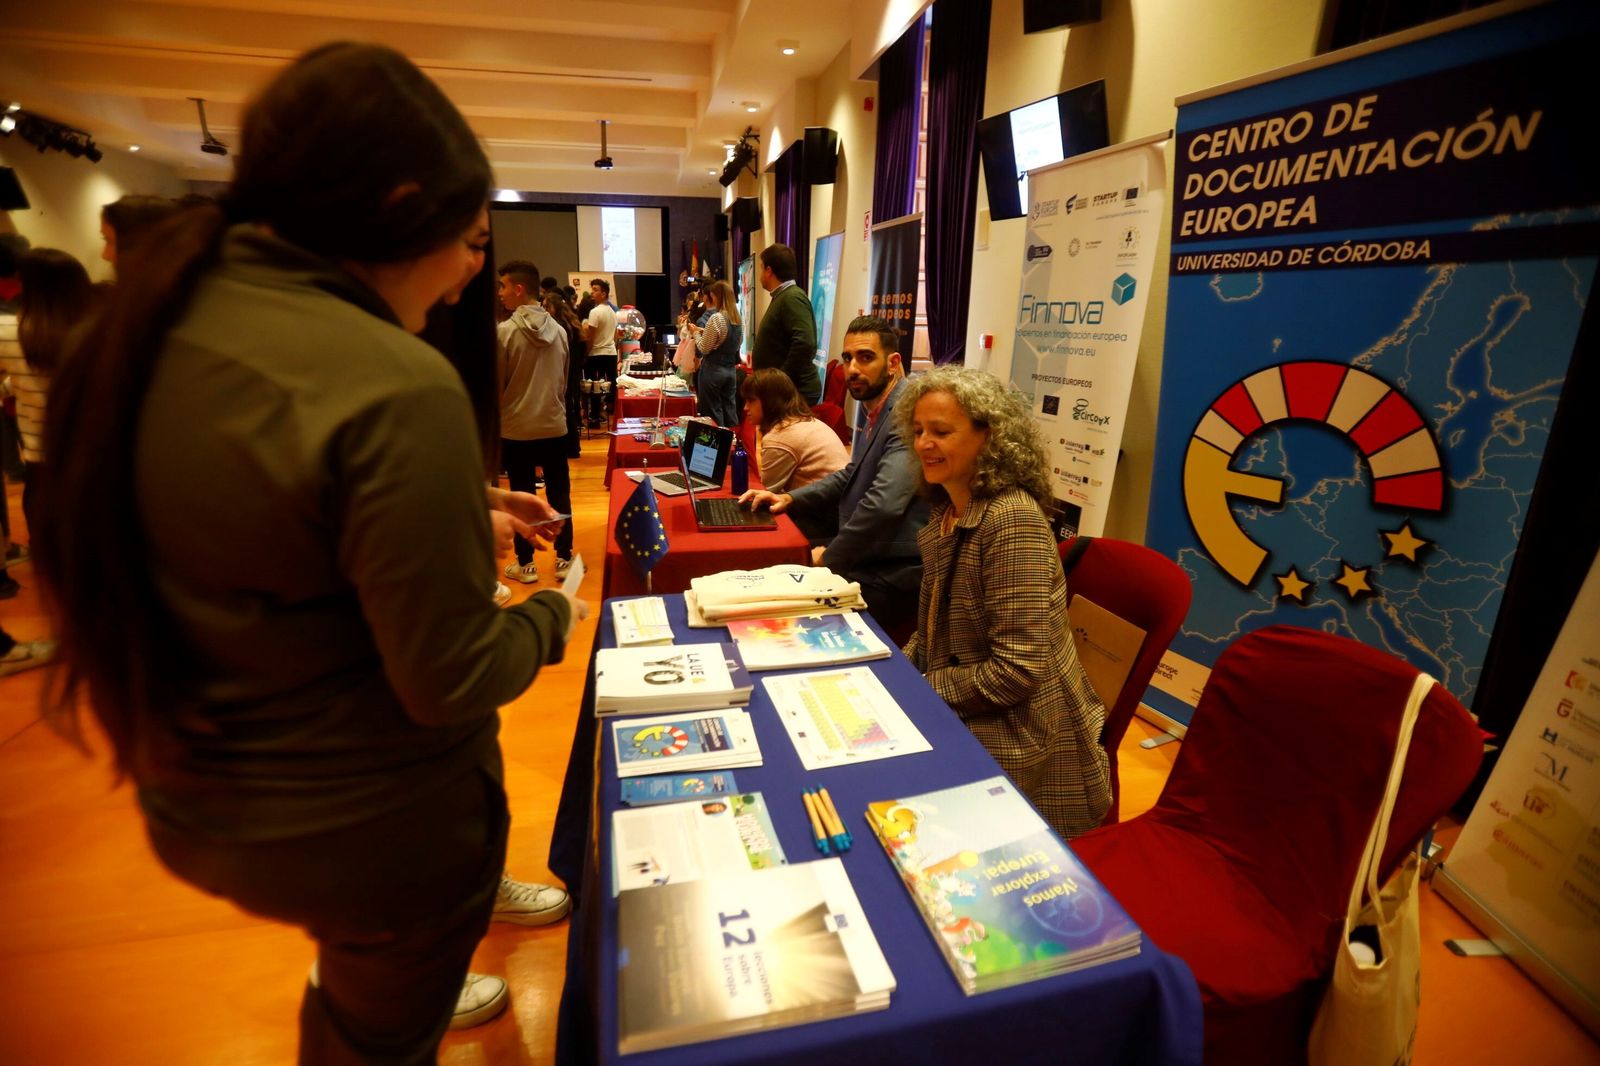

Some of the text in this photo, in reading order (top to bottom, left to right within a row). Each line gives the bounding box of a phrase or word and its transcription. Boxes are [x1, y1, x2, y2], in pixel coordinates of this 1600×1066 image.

[1187, 95, 1378, 162] CENTRO DE
[1183, 107, 1543, 201] DOCUMENTACIÓN
[1180, 196, 1318, 237] EUROPEA
[1177, 239, 1431, 271] UNIVERSIDAD DE CÓRDOBA
[882, 293, 913, 305] semos
[1020, 294, 1104, 325] Finnova
[1093, 332, 1128, 343] europea
[1032, 373, 1092, 389] PROYECTOS EUROPEOS
[643, 654, 685, 685] YO
[687, 653, 701, 663] LA
[689, 665, 705, 676] UE
[991, 869, 1048, 897] explorar
[718, 909, 757, 949] 12
[753, 951, 773, 1005] lecciones
